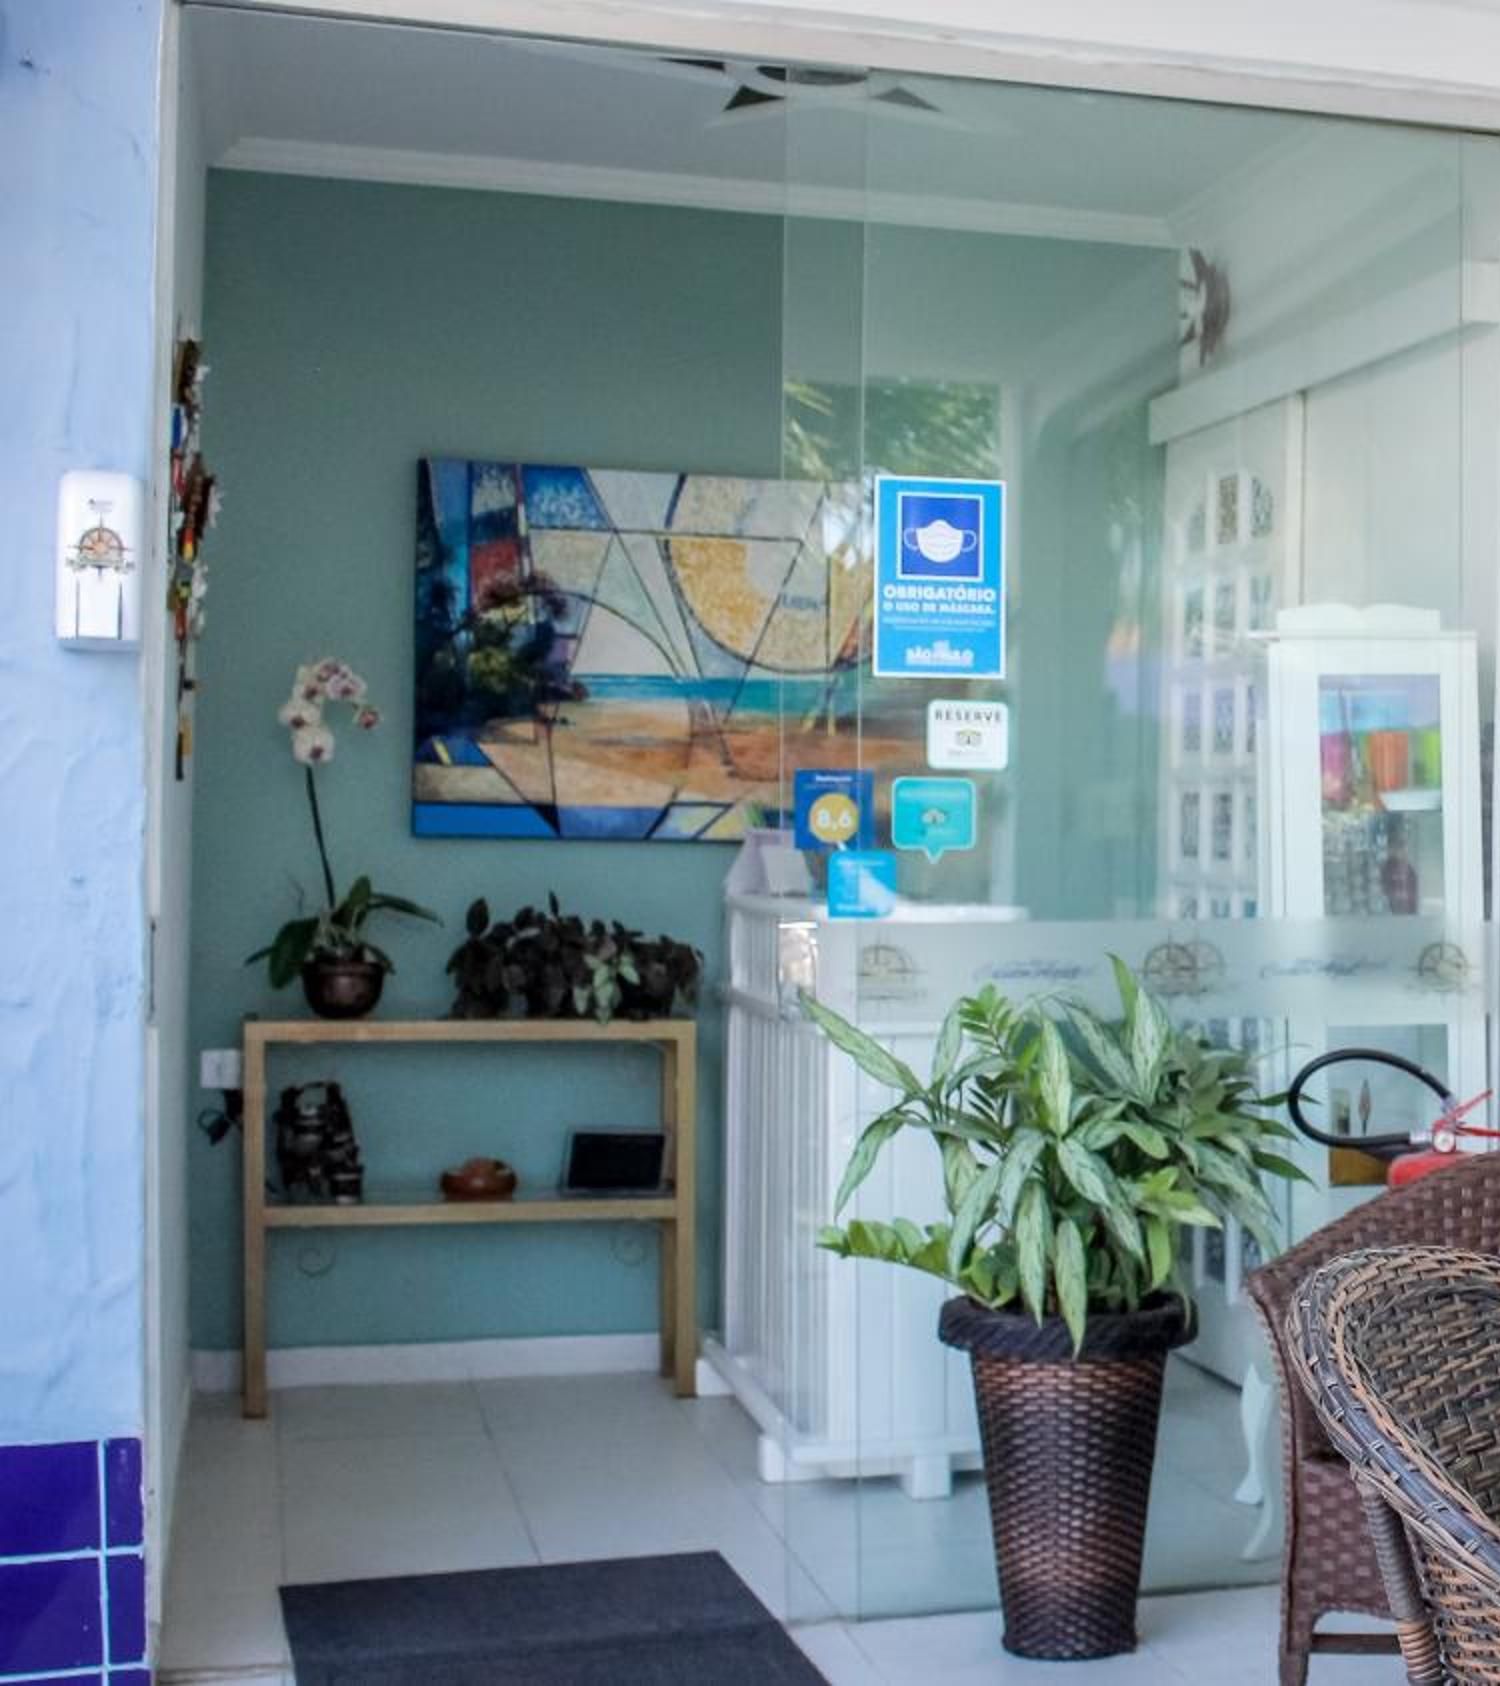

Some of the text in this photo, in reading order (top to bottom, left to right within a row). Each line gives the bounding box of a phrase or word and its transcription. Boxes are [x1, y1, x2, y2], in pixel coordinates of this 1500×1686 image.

[883, 584, 996, 602] OBRIGATÓRIO
[935, 709, 1002, 722] RESERVE
[816, 807, 853, 830] 8,6
